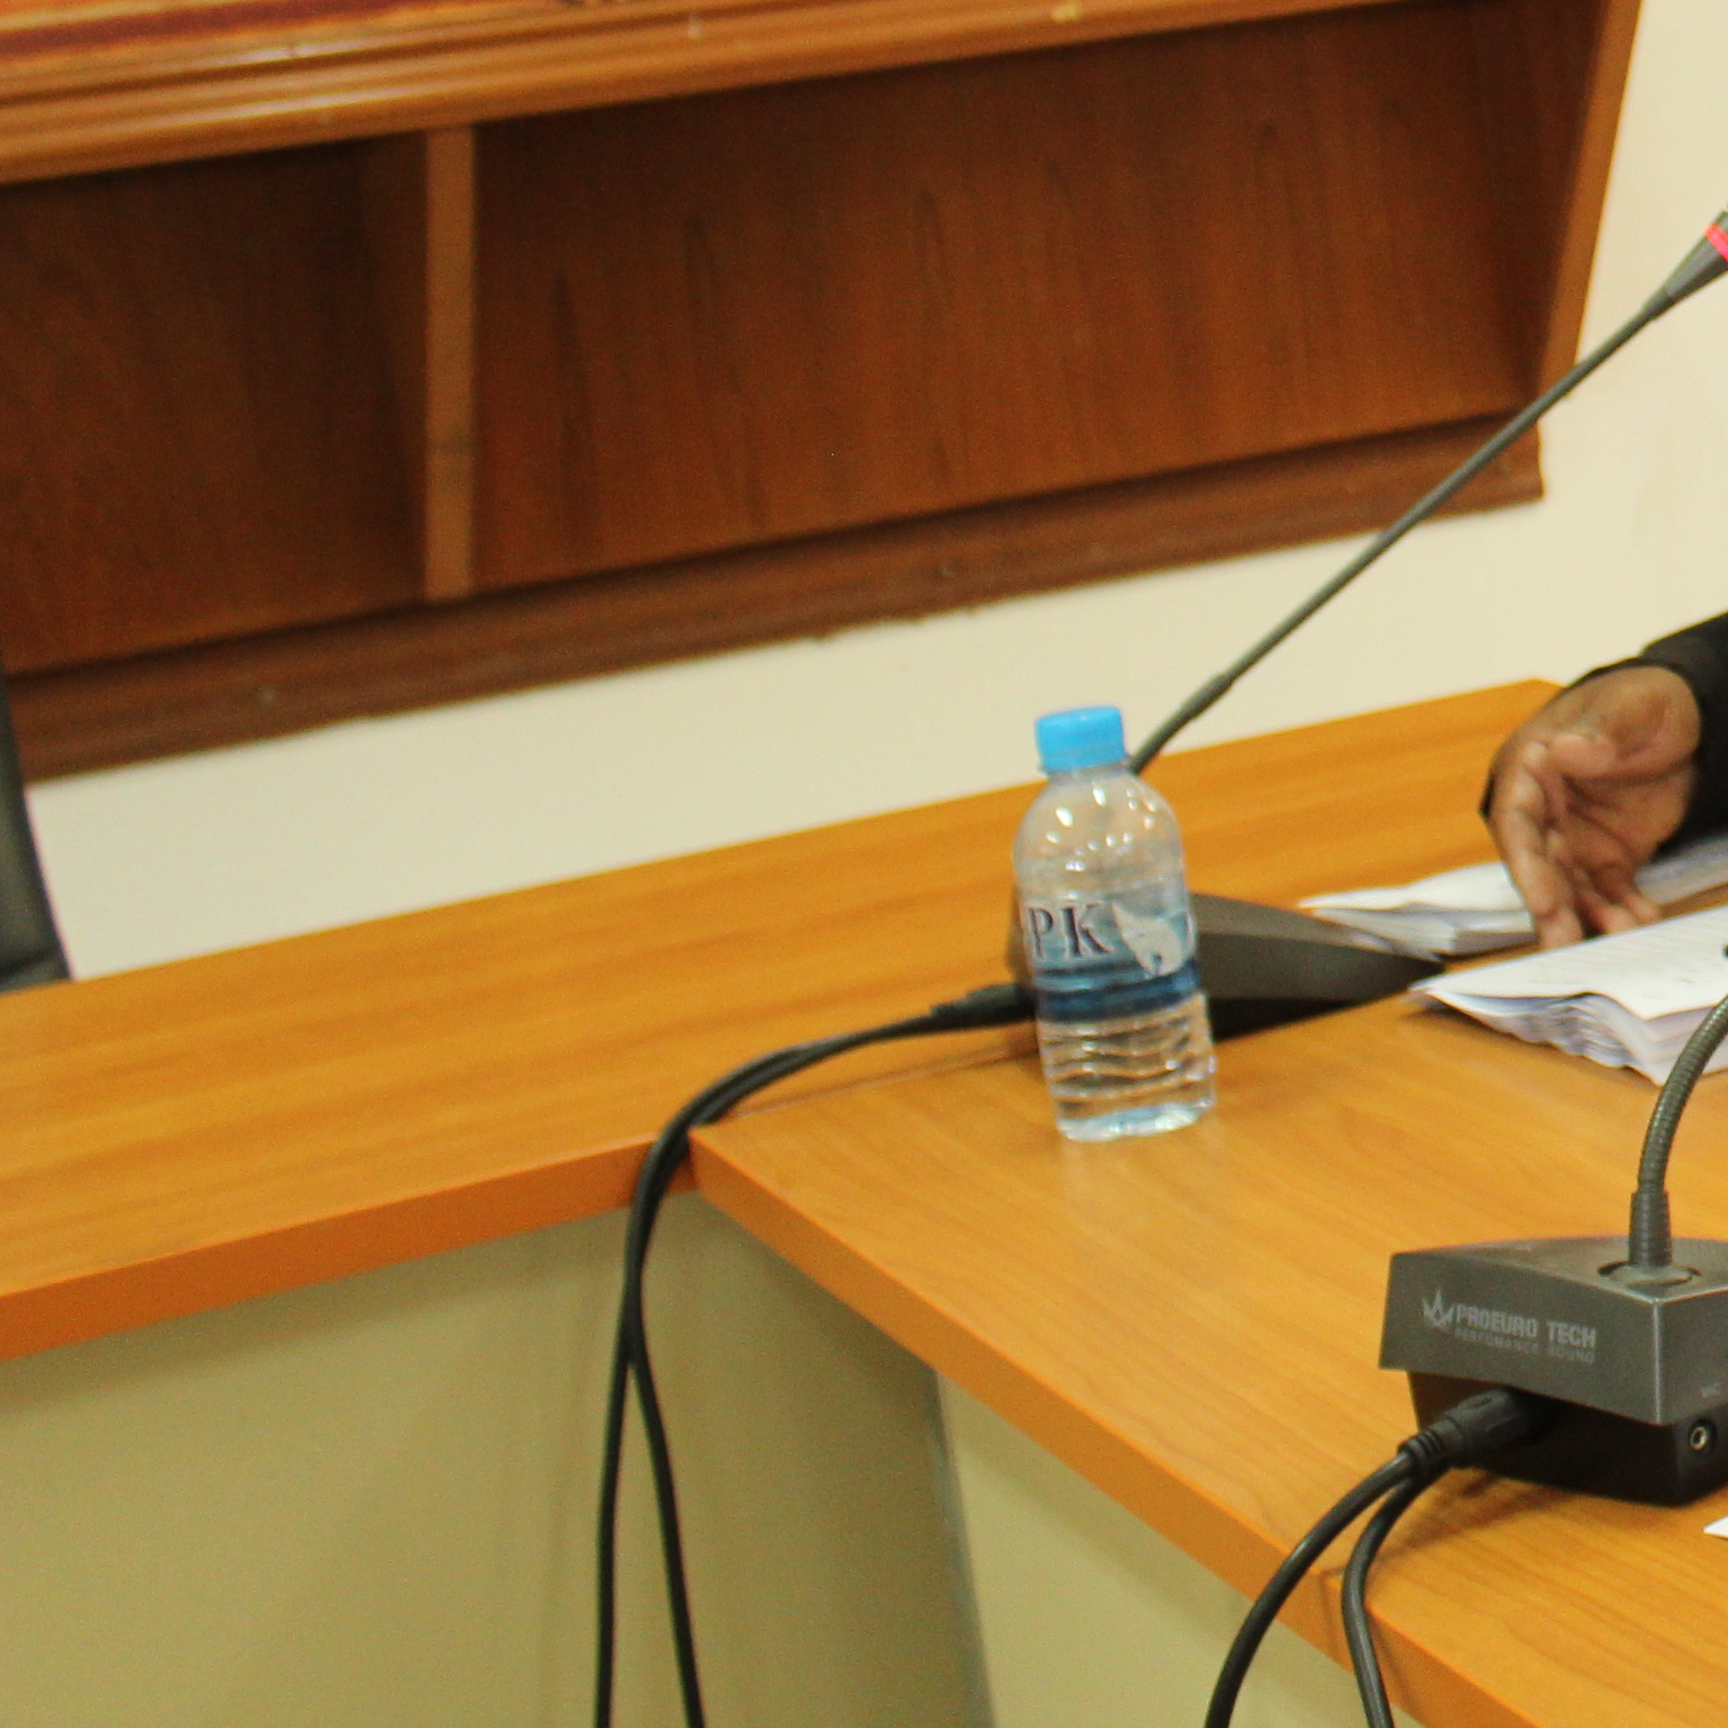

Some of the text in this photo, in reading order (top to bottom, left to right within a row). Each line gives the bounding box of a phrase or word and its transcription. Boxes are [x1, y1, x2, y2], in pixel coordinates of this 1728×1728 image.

[1028, 902, 1114, 958] PK
[1455, 1302, 1597, 1349] PROEURO TECH
